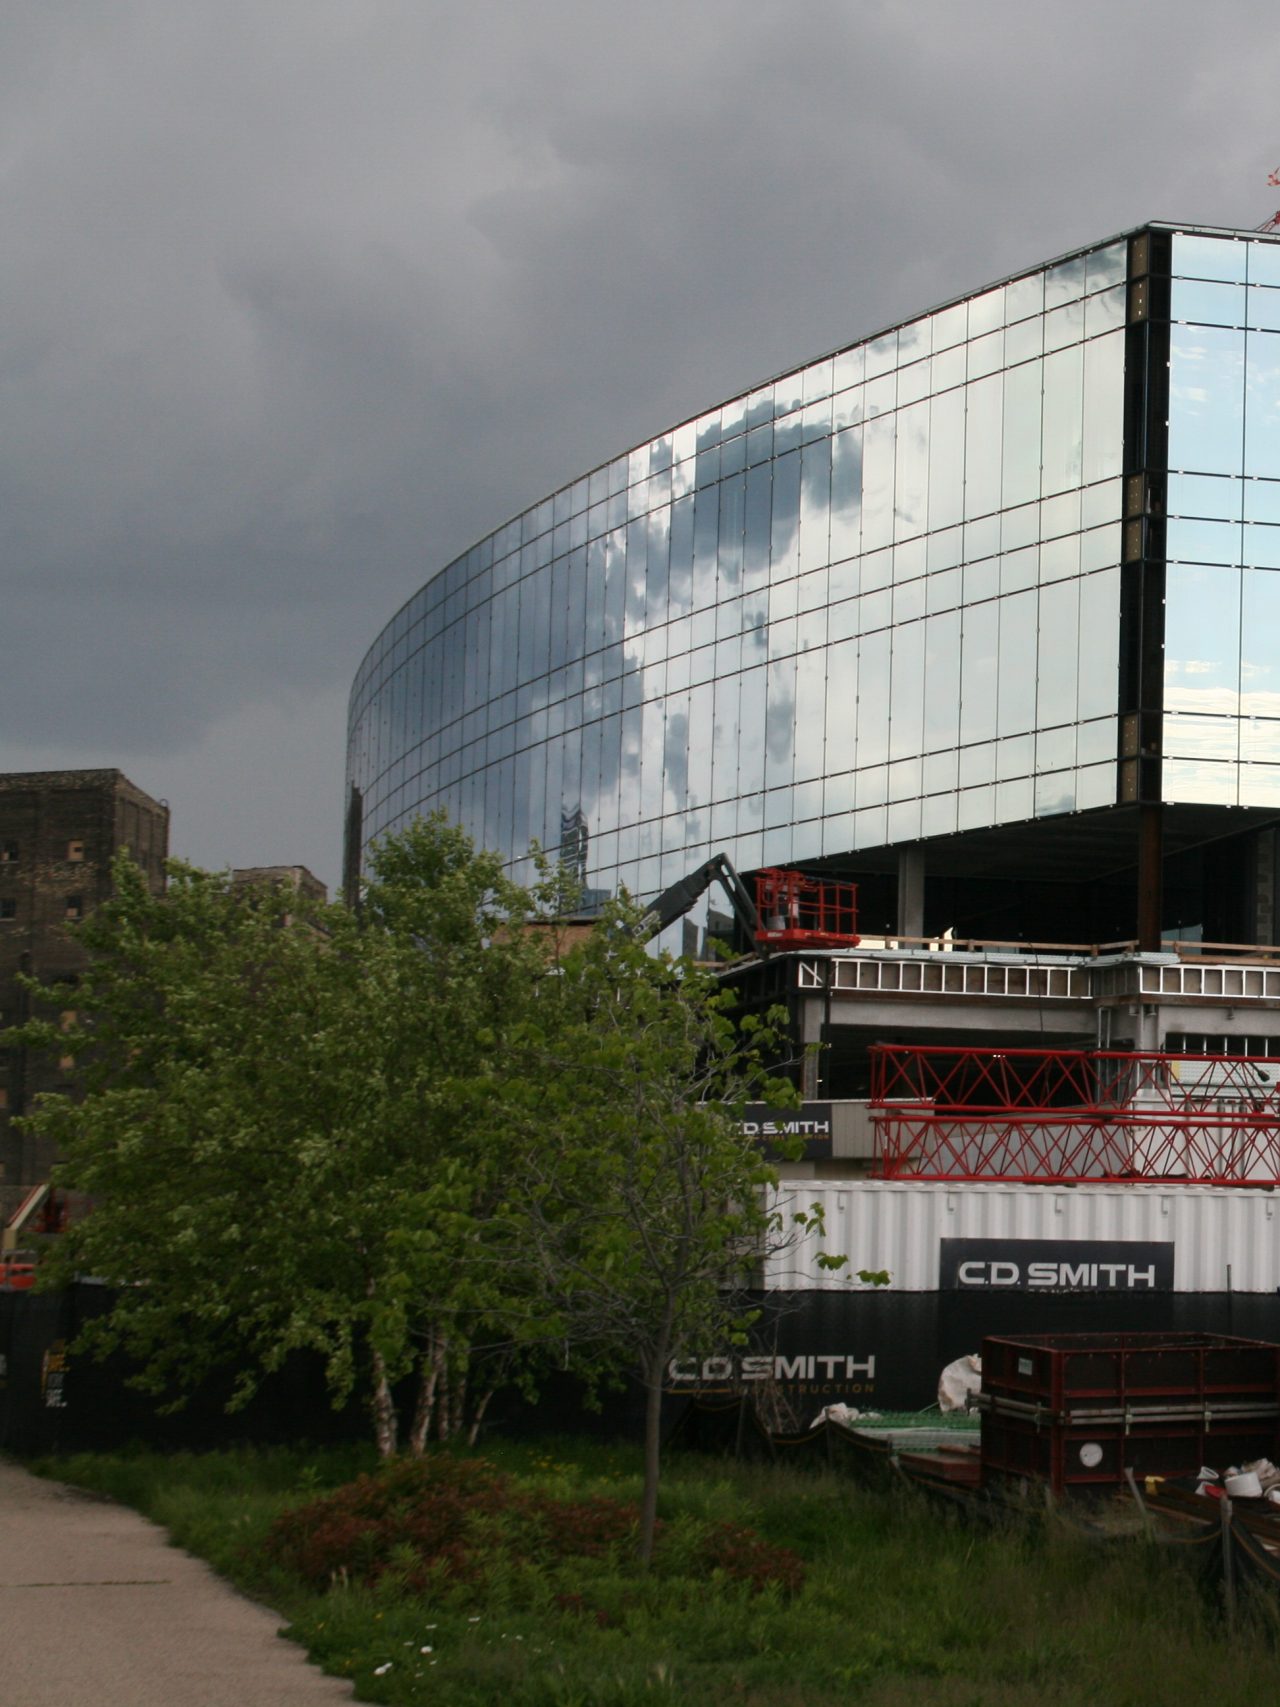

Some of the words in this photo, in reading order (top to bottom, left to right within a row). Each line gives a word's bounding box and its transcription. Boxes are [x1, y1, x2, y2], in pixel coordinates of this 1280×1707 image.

[762, 1120, 829, 1135] SMITH
[958, 1261, 1021, 1286] C.D.
[1027, 1262, 1156, 1288] SMITH
[668, 1356, 734, 1381] C.D.
[741, 1354, 876, 1381] SMITH
